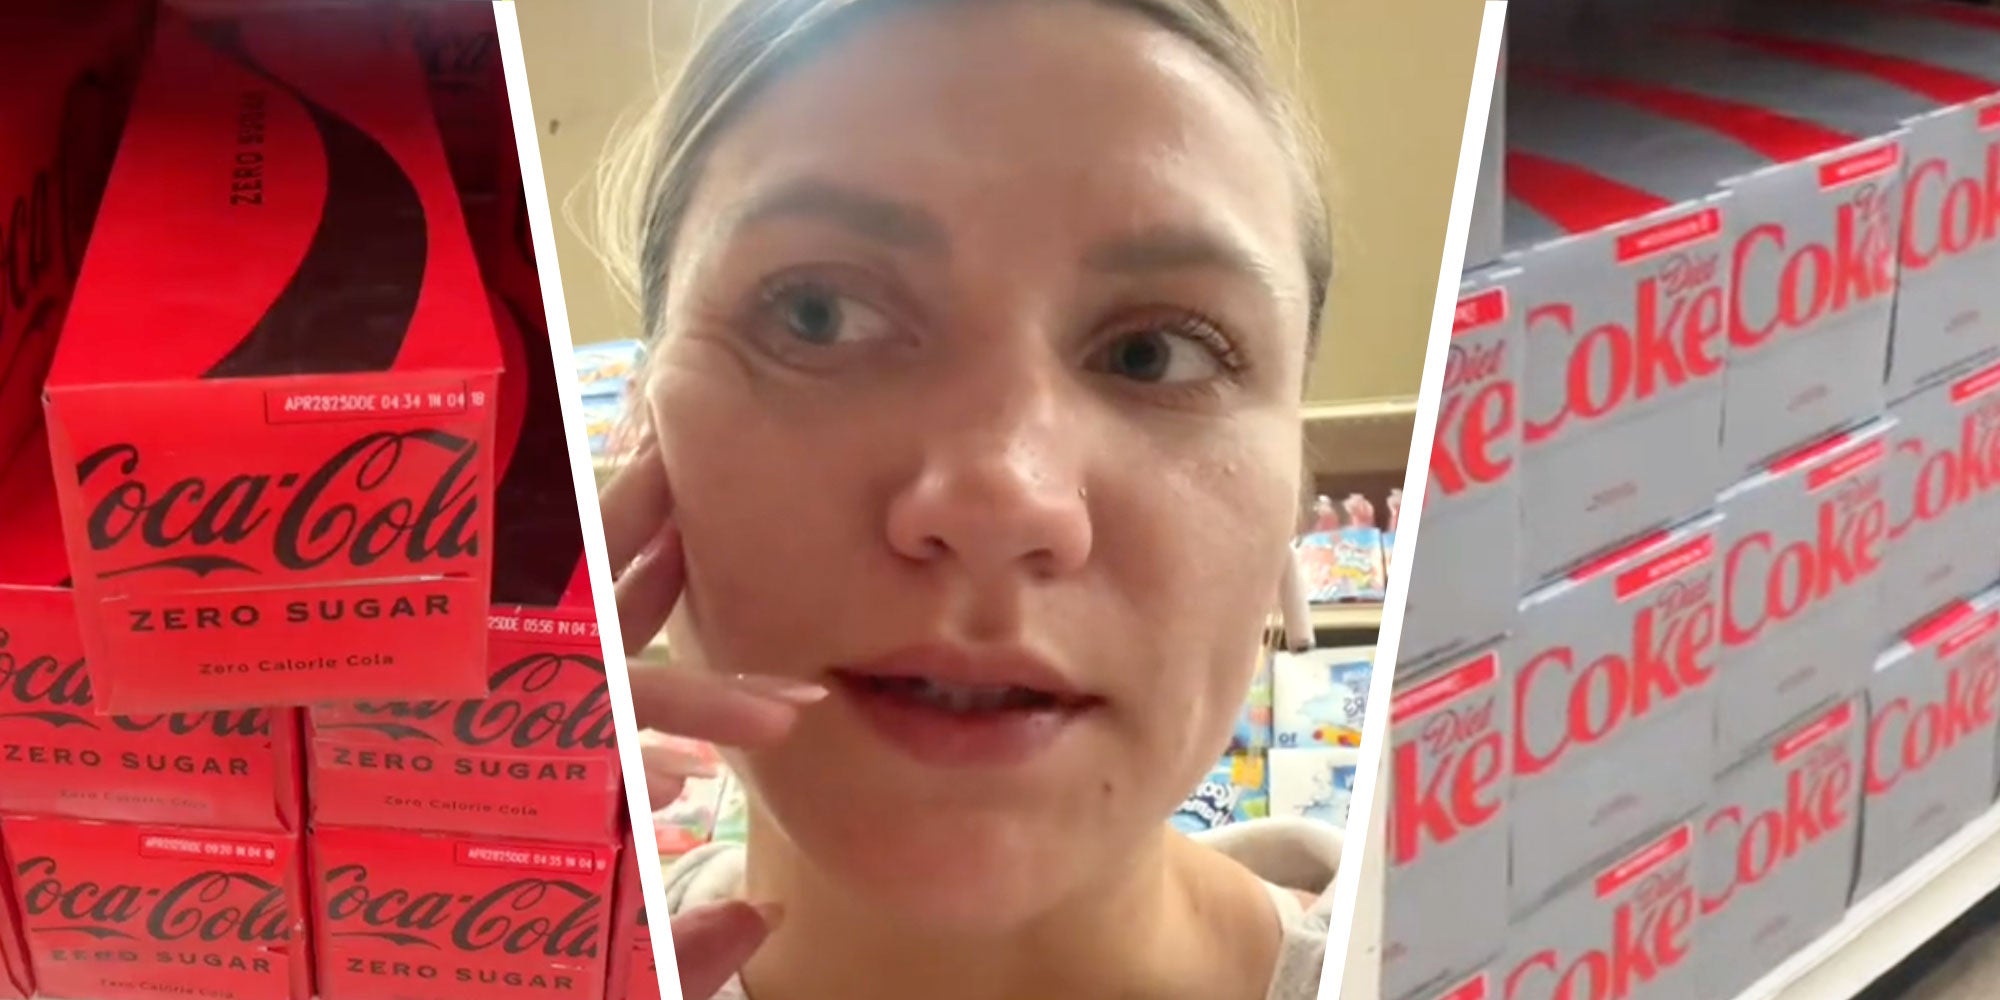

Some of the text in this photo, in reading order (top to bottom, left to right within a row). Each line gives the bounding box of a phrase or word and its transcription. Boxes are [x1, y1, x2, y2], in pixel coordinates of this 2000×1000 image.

[230, 153, 263, 206] ZERO
[1720, 500, 1886, 647] Coke
[129, 594, 451, 632] ZERO SUGAR
[199, 654, 394, 675] Zero Calorie Cola
[1513, 606, 1717, 776] Coke
[1423, 698, 1496, 757] Diet
[1864, 655, 1999, 796] Coke
[3, 744, 249, 776] ZERO SUGAR
[333, 748, 588, 781] ZERO SUGAR
[156, 951, 271, 974] SUGAR
[346, 958, 574, 990] ZERO SUGAR
